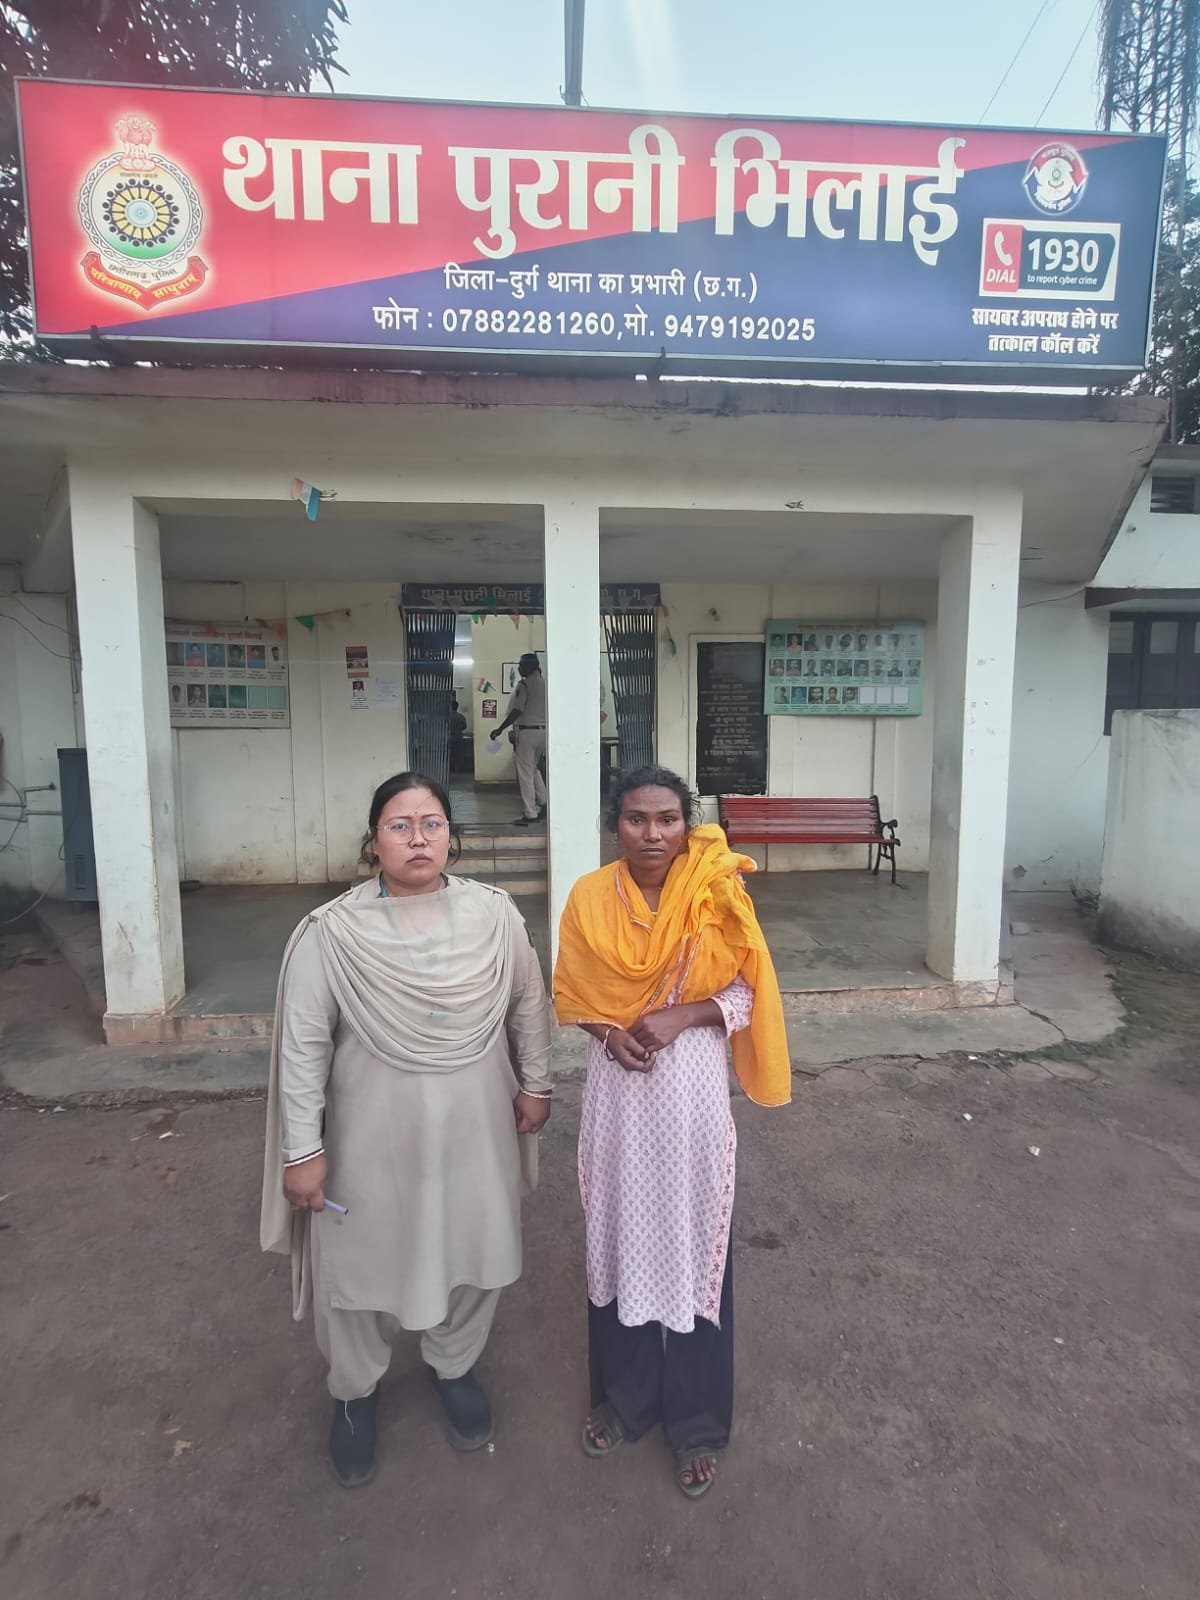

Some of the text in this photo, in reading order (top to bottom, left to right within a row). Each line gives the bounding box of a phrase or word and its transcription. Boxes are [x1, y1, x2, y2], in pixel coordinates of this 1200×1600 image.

[222, 124, 966, 266] थाना पुरानी भिलाई
[1028, 238, 1099, 273] 1930
[547, 272, 592, 293] थाना
[598, 273, 624, 294] का
[630, 268, 686, 296] प्रभारी
[693, 270, 758, 303] (छ.ग.)
[986, 268, 1017, 284] DIAL
[1027, 274, 1098, 286] to report cyber crime
[372, 296, 419, 331] फोन
[664, 314, 815, 342] 9479192025
[971, 307, 1119, 329] सायबर अपराध होने पर
[988, 333, 1100, 355] तत्काल कॉल करें
